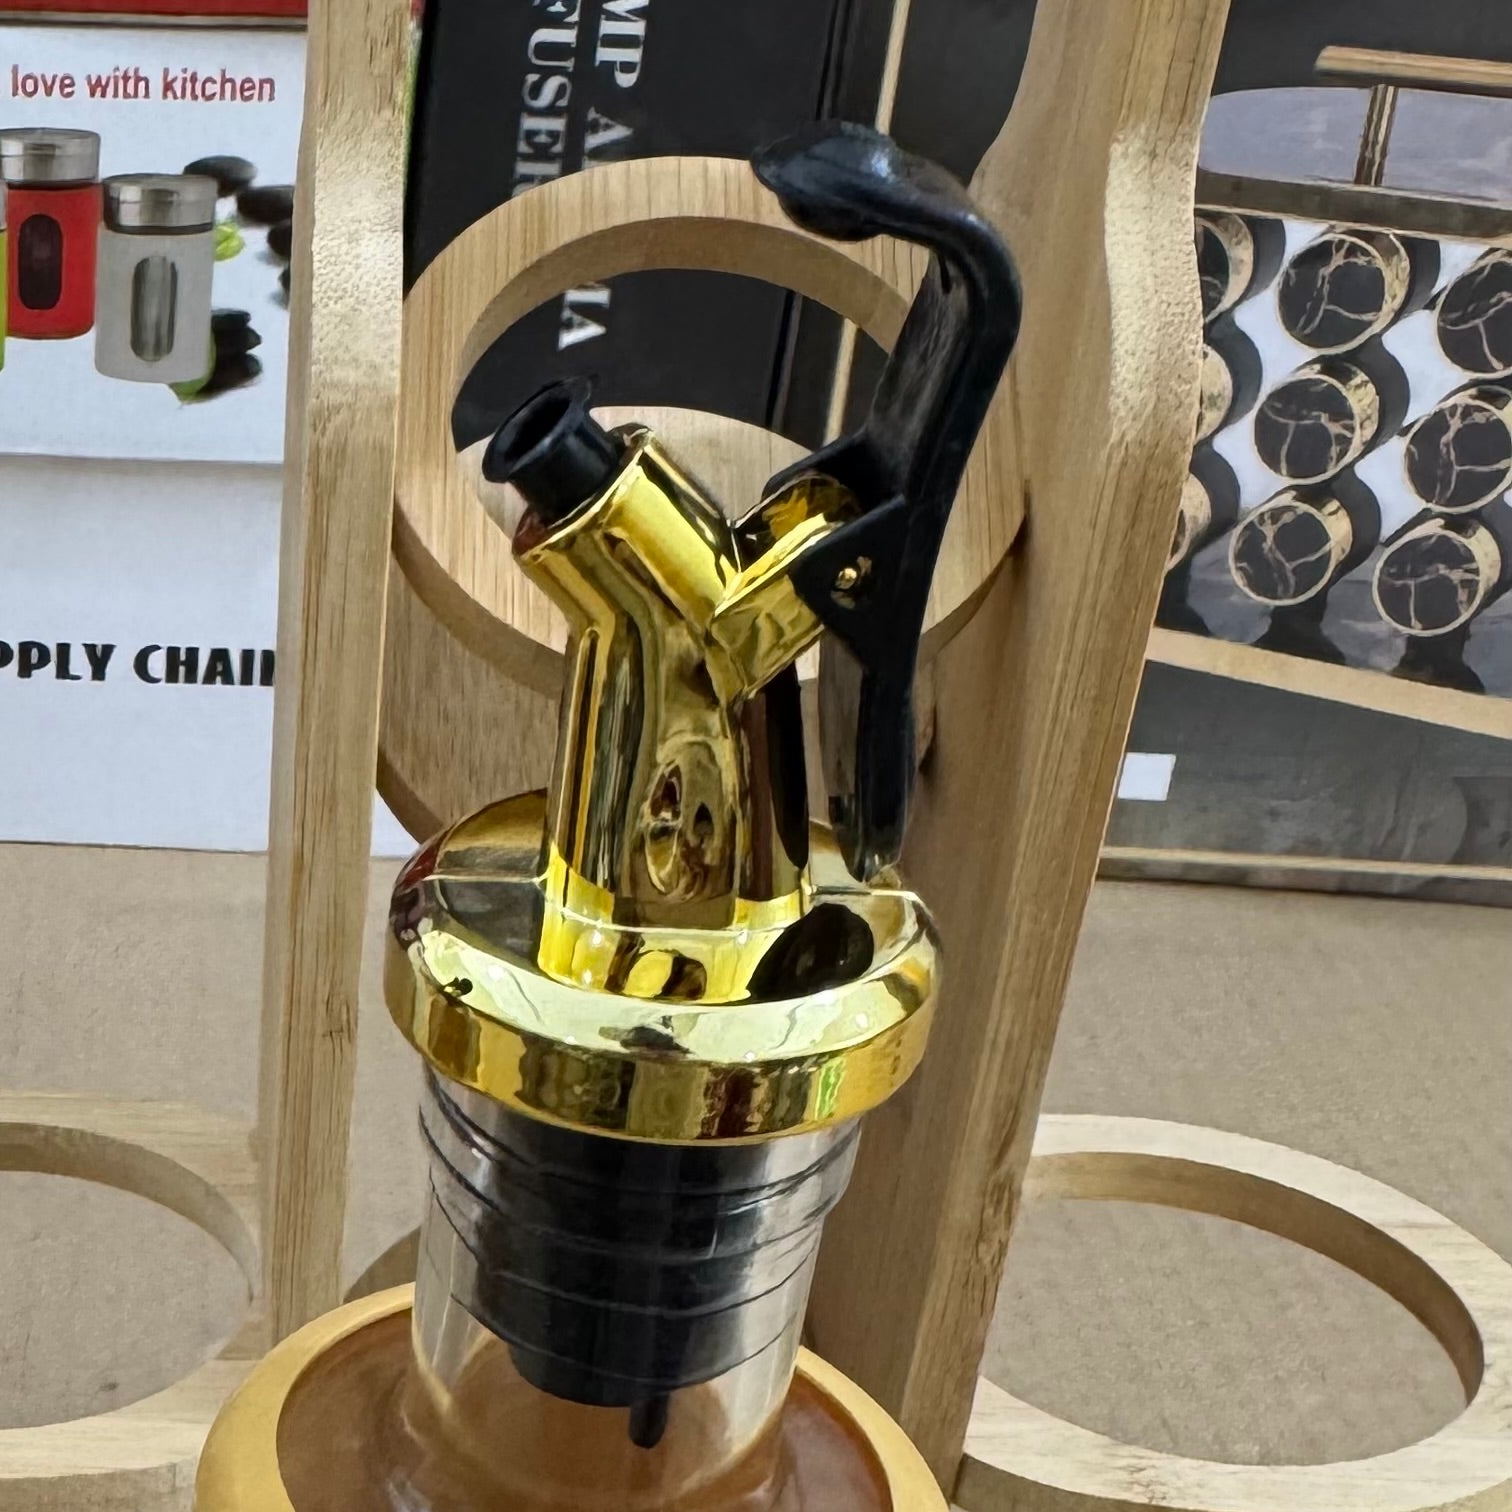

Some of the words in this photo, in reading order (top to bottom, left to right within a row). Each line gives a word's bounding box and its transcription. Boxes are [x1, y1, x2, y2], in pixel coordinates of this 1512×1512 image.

[11, 64, 76, 98] love
[85, 65, 150, 100] with
[161, 67, 276, 102] kitchen
